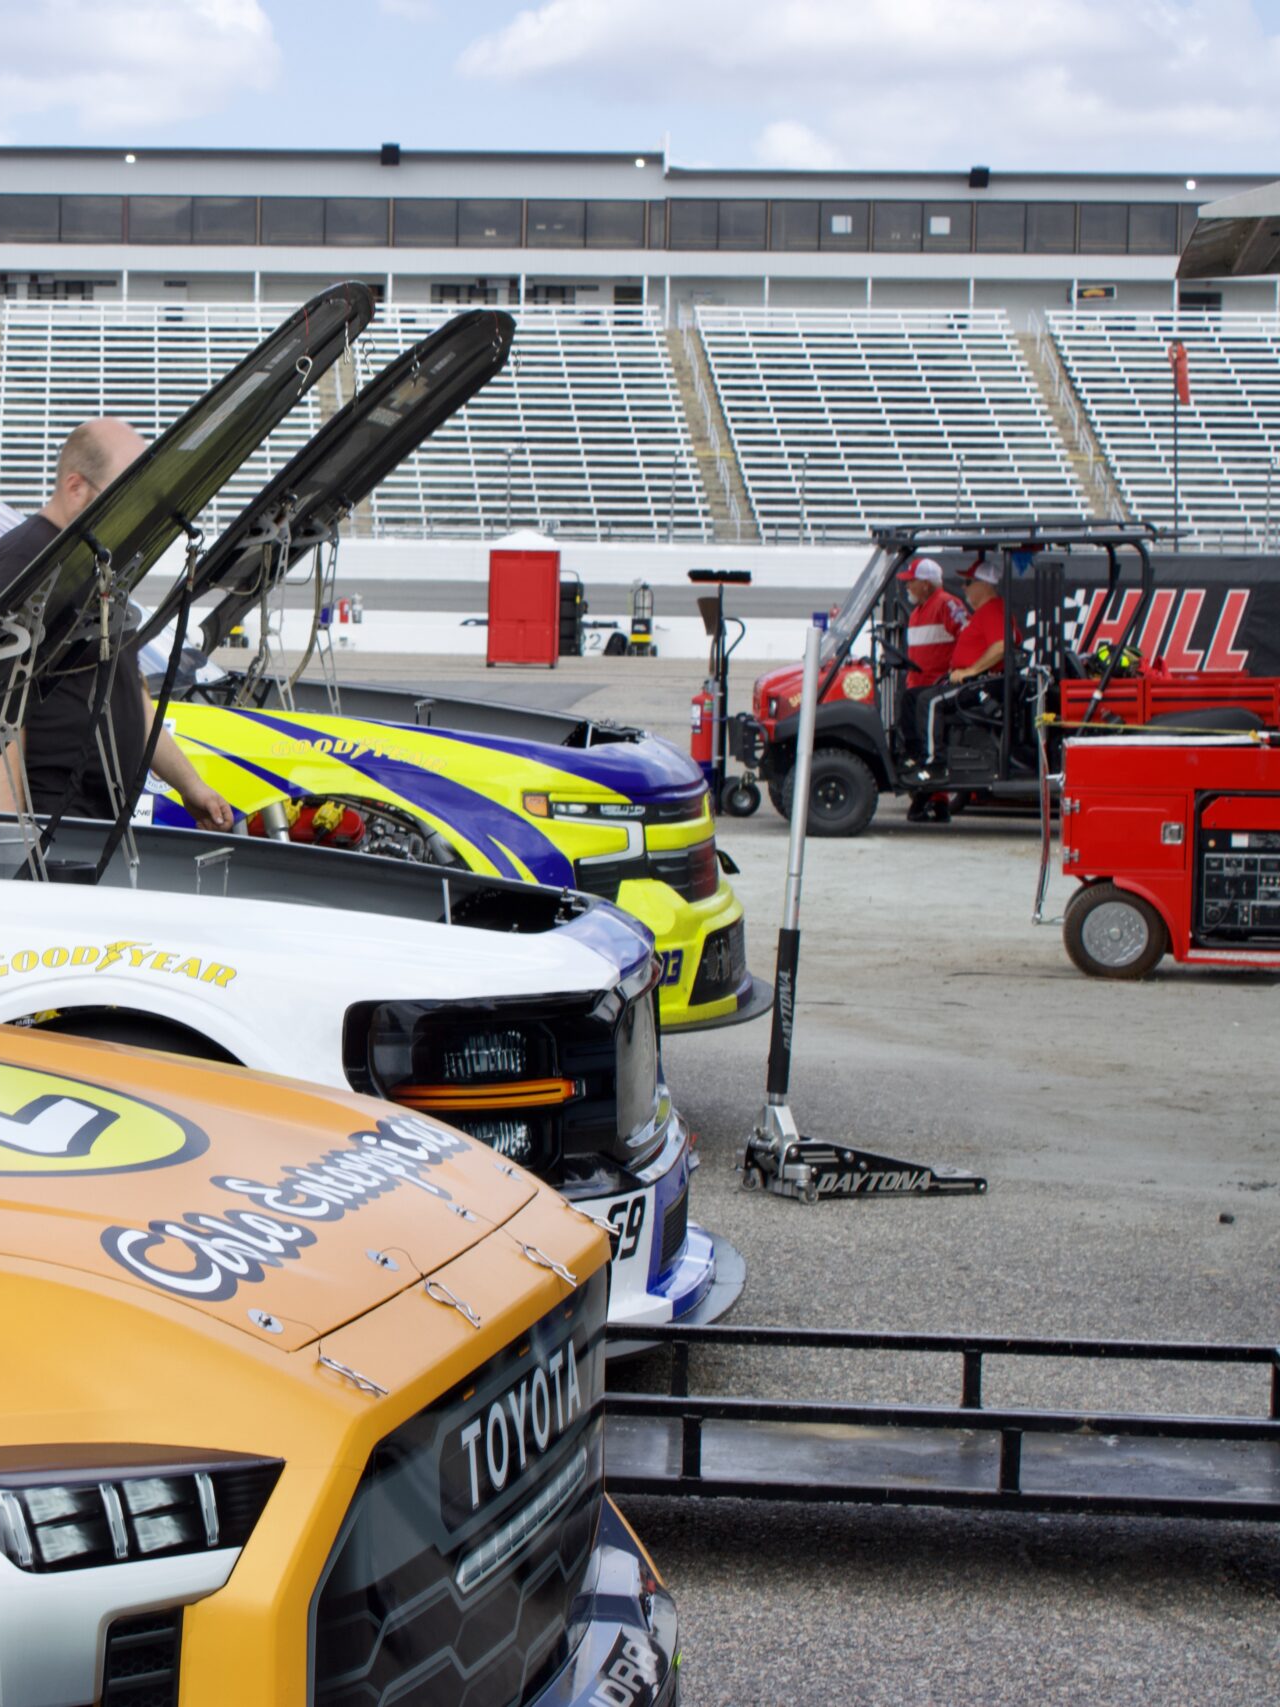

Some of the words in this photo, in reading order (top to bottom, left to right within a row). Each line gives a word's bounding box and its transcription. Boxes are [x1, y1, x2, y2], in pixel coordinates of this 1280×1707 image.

[1074, 588, 1251, 672] HILL
[270, 736, 448, 773] GOODYEAR
[778, 970, 794, 1050] DAYTONA
[818, 1170, 932, 1193] DAYTONA
[461, 1339, 581, 1510] TOYOTA
